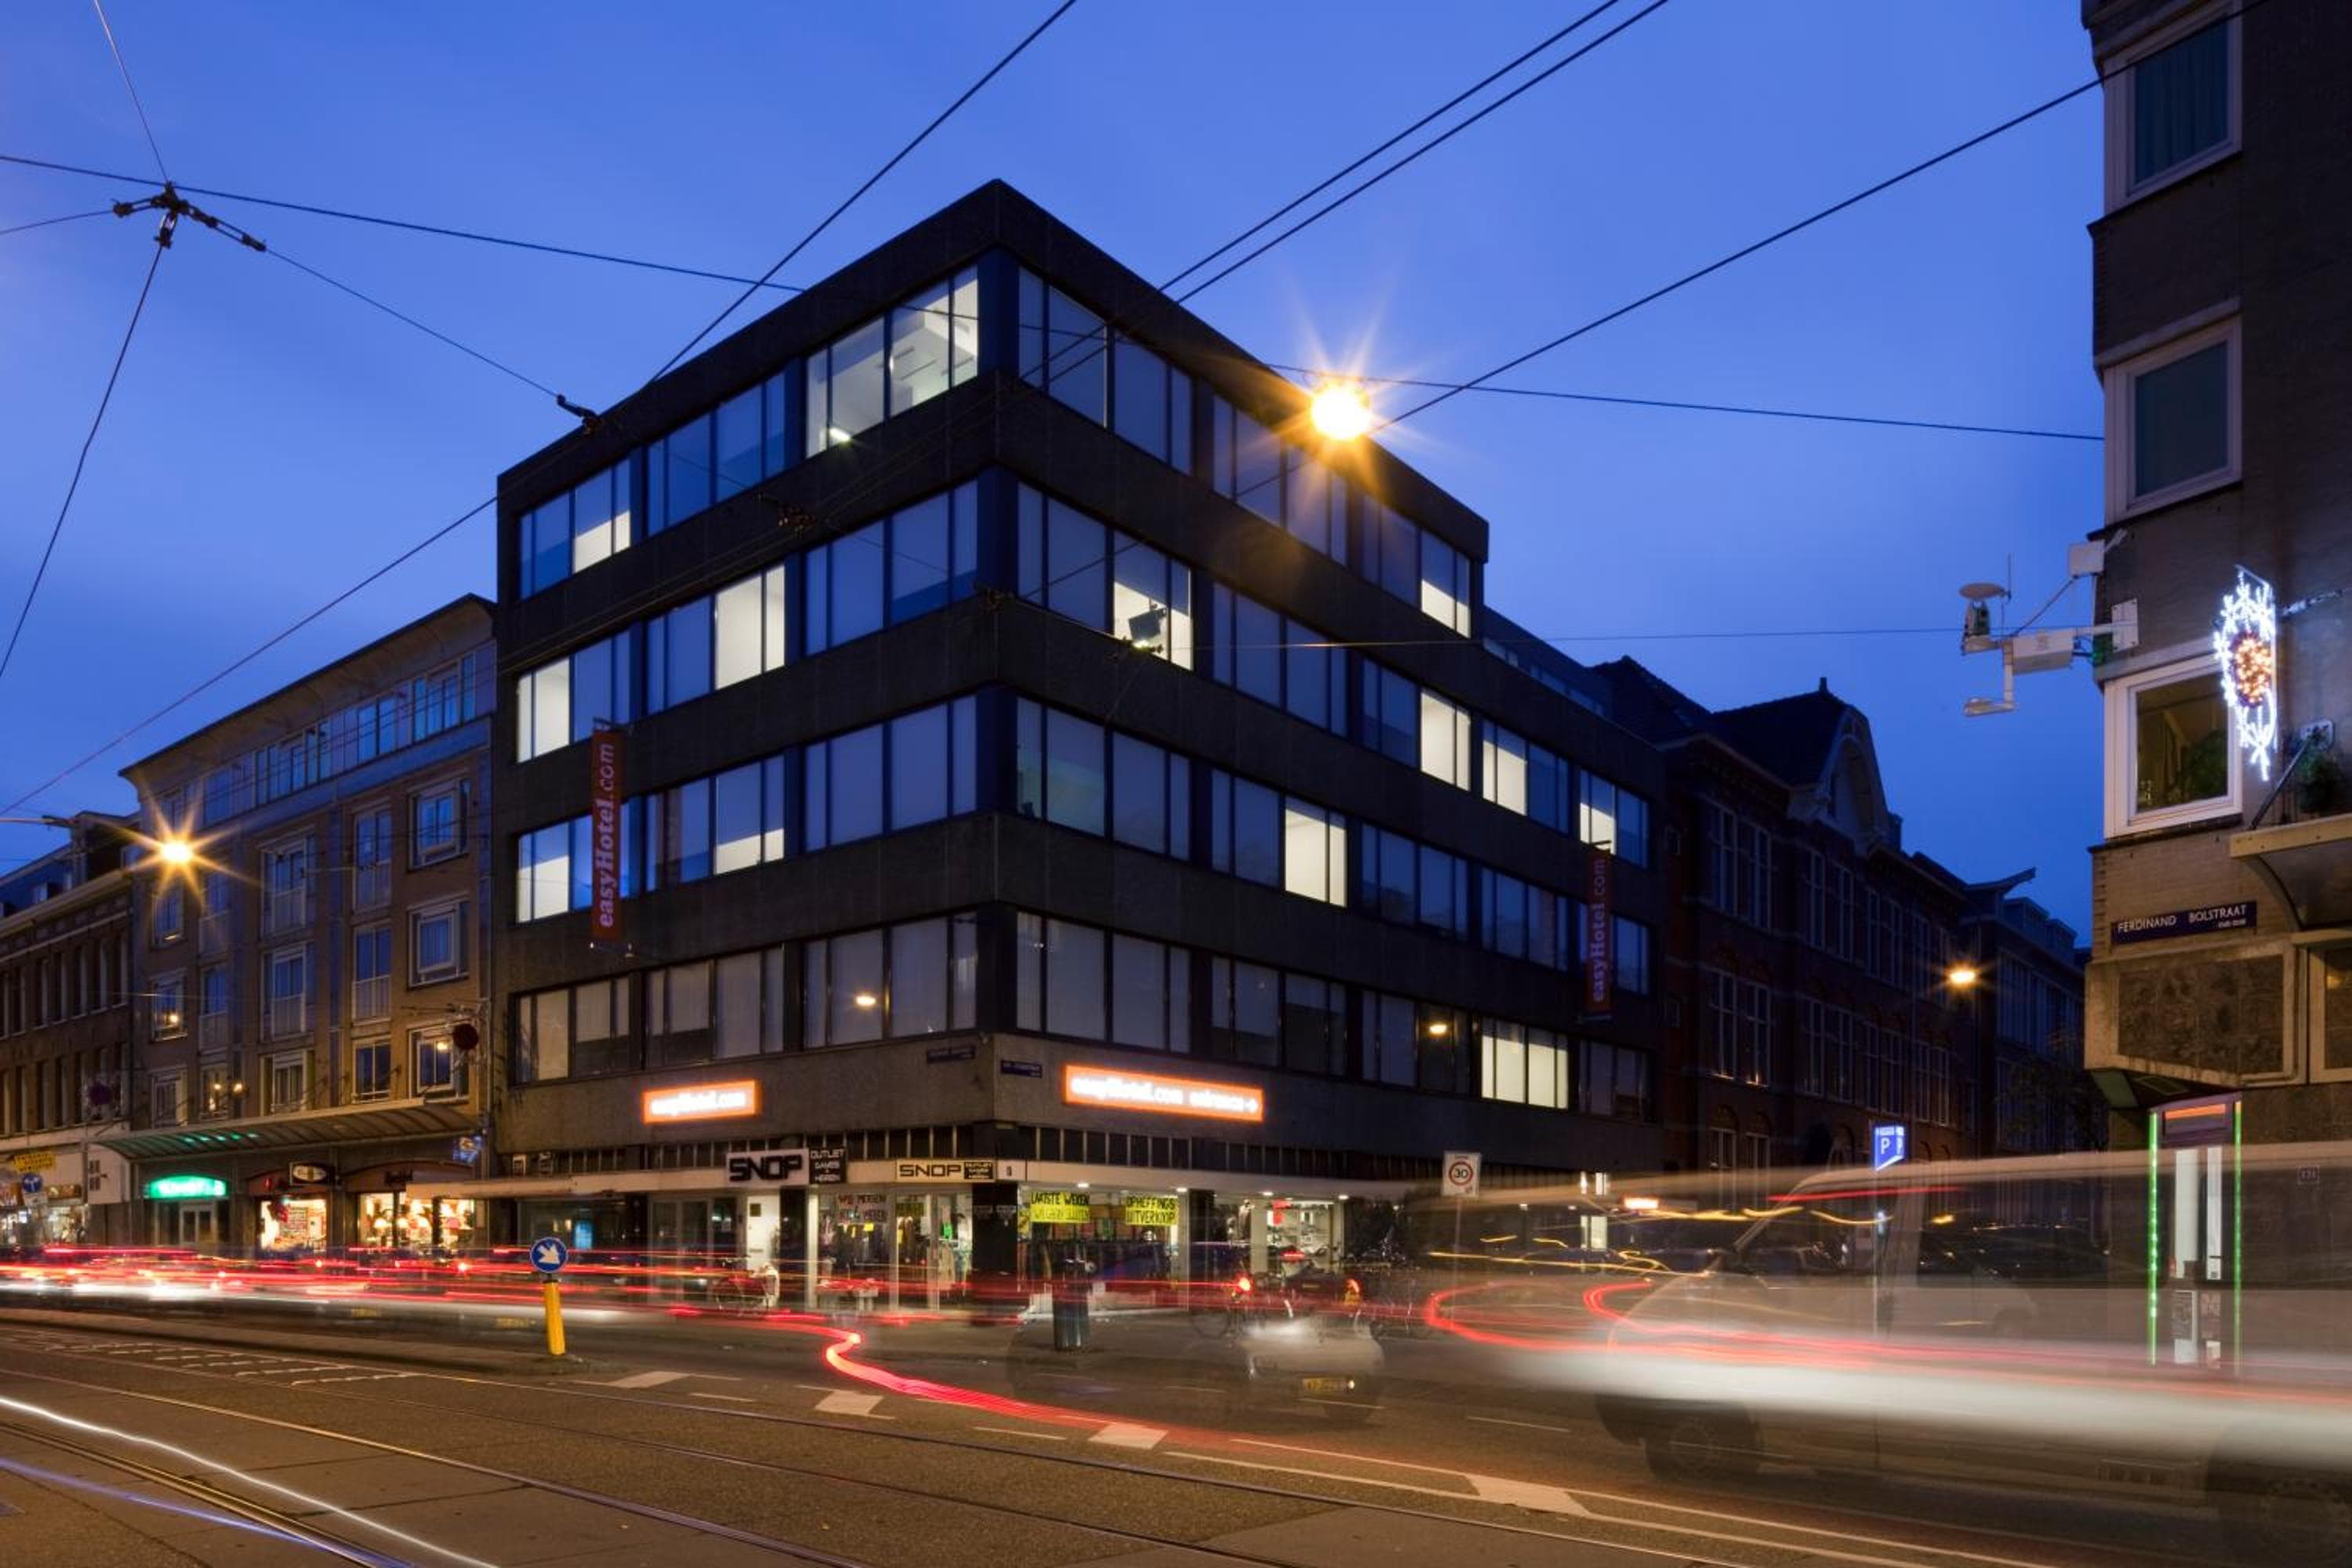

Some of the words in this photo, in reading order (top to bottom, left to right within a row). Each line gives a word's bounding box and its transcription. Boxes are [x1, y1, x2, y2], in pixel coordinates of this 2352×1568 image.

[595, 742, 617, 928] easyHotel.com
[2118, 915, 2176, 933] FERDINAND
[2188, 905, 2246, 924] BOLSTRAAT
[810, 1149, 844, 1159] OUTLET
[729, 1154, 802, 1181] SNOP
[899, 1164, 961, 1177] SNOP
[1454, 1168, 1468, 1178] 30
